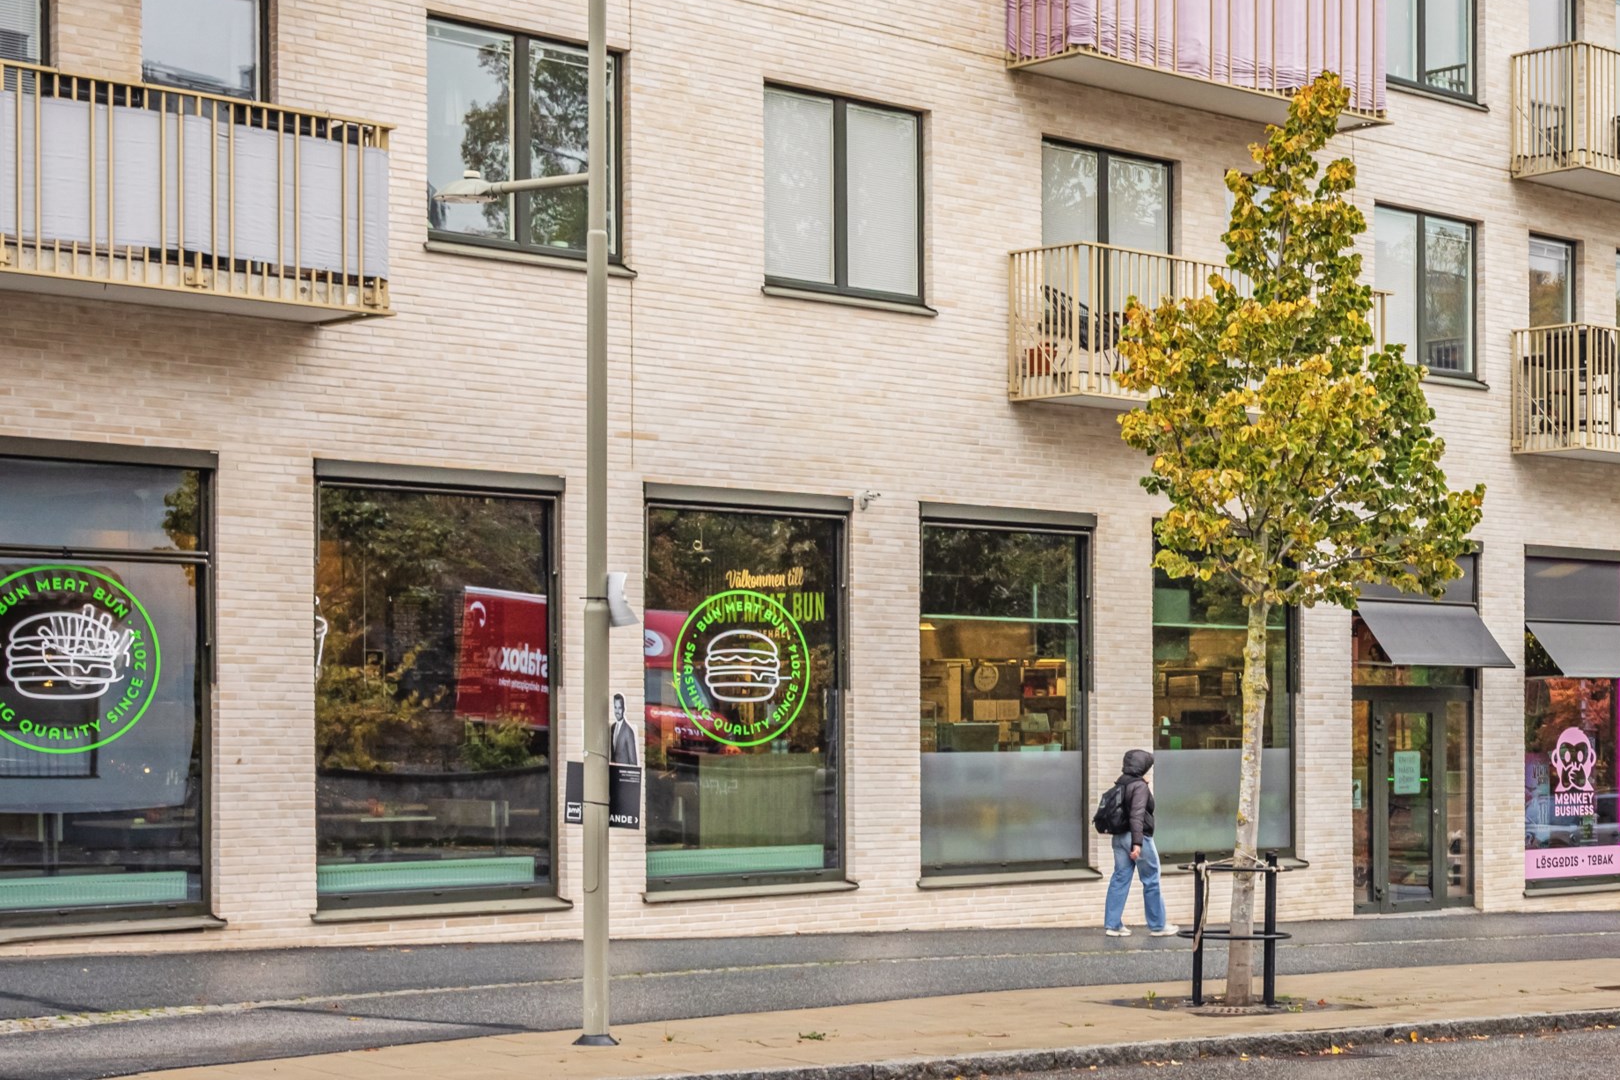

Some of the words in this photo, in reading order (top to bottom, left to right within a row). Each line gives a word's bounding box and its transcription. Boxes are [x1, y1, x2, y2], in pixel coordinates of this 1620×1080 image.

[725, 569, 785, 589] Välkommen
[787, 566, 804, 586] till
[36, 577, 88, 593] MEAT
[93, 587, 128, 618] BUN
[793, 592, 825, 622] BUN
[696, 606, 722, 632] BUN
[725, 601, 761, 614] MEAT
[763, 609, 789, 634] BUN
[19, 719, 102, 740] QUALITY
[106, 676, 144, 724] SINCE
[131, 629, 146, 672] 2014
[684, 641, 712, 720] SMASHING
[713, 718, 770, 736] QUALITY
[773, 683, 799, 722] SINCE
[788, 644, 801, 679] 2014
[1555, 792, 1594, 805] MONKEY
[1555, 805, 1594, 817] BUSINESS
[1536, 855, 1579, 869] LÖSGODIS
[1587, 854, 1613, 866] TOBAK
